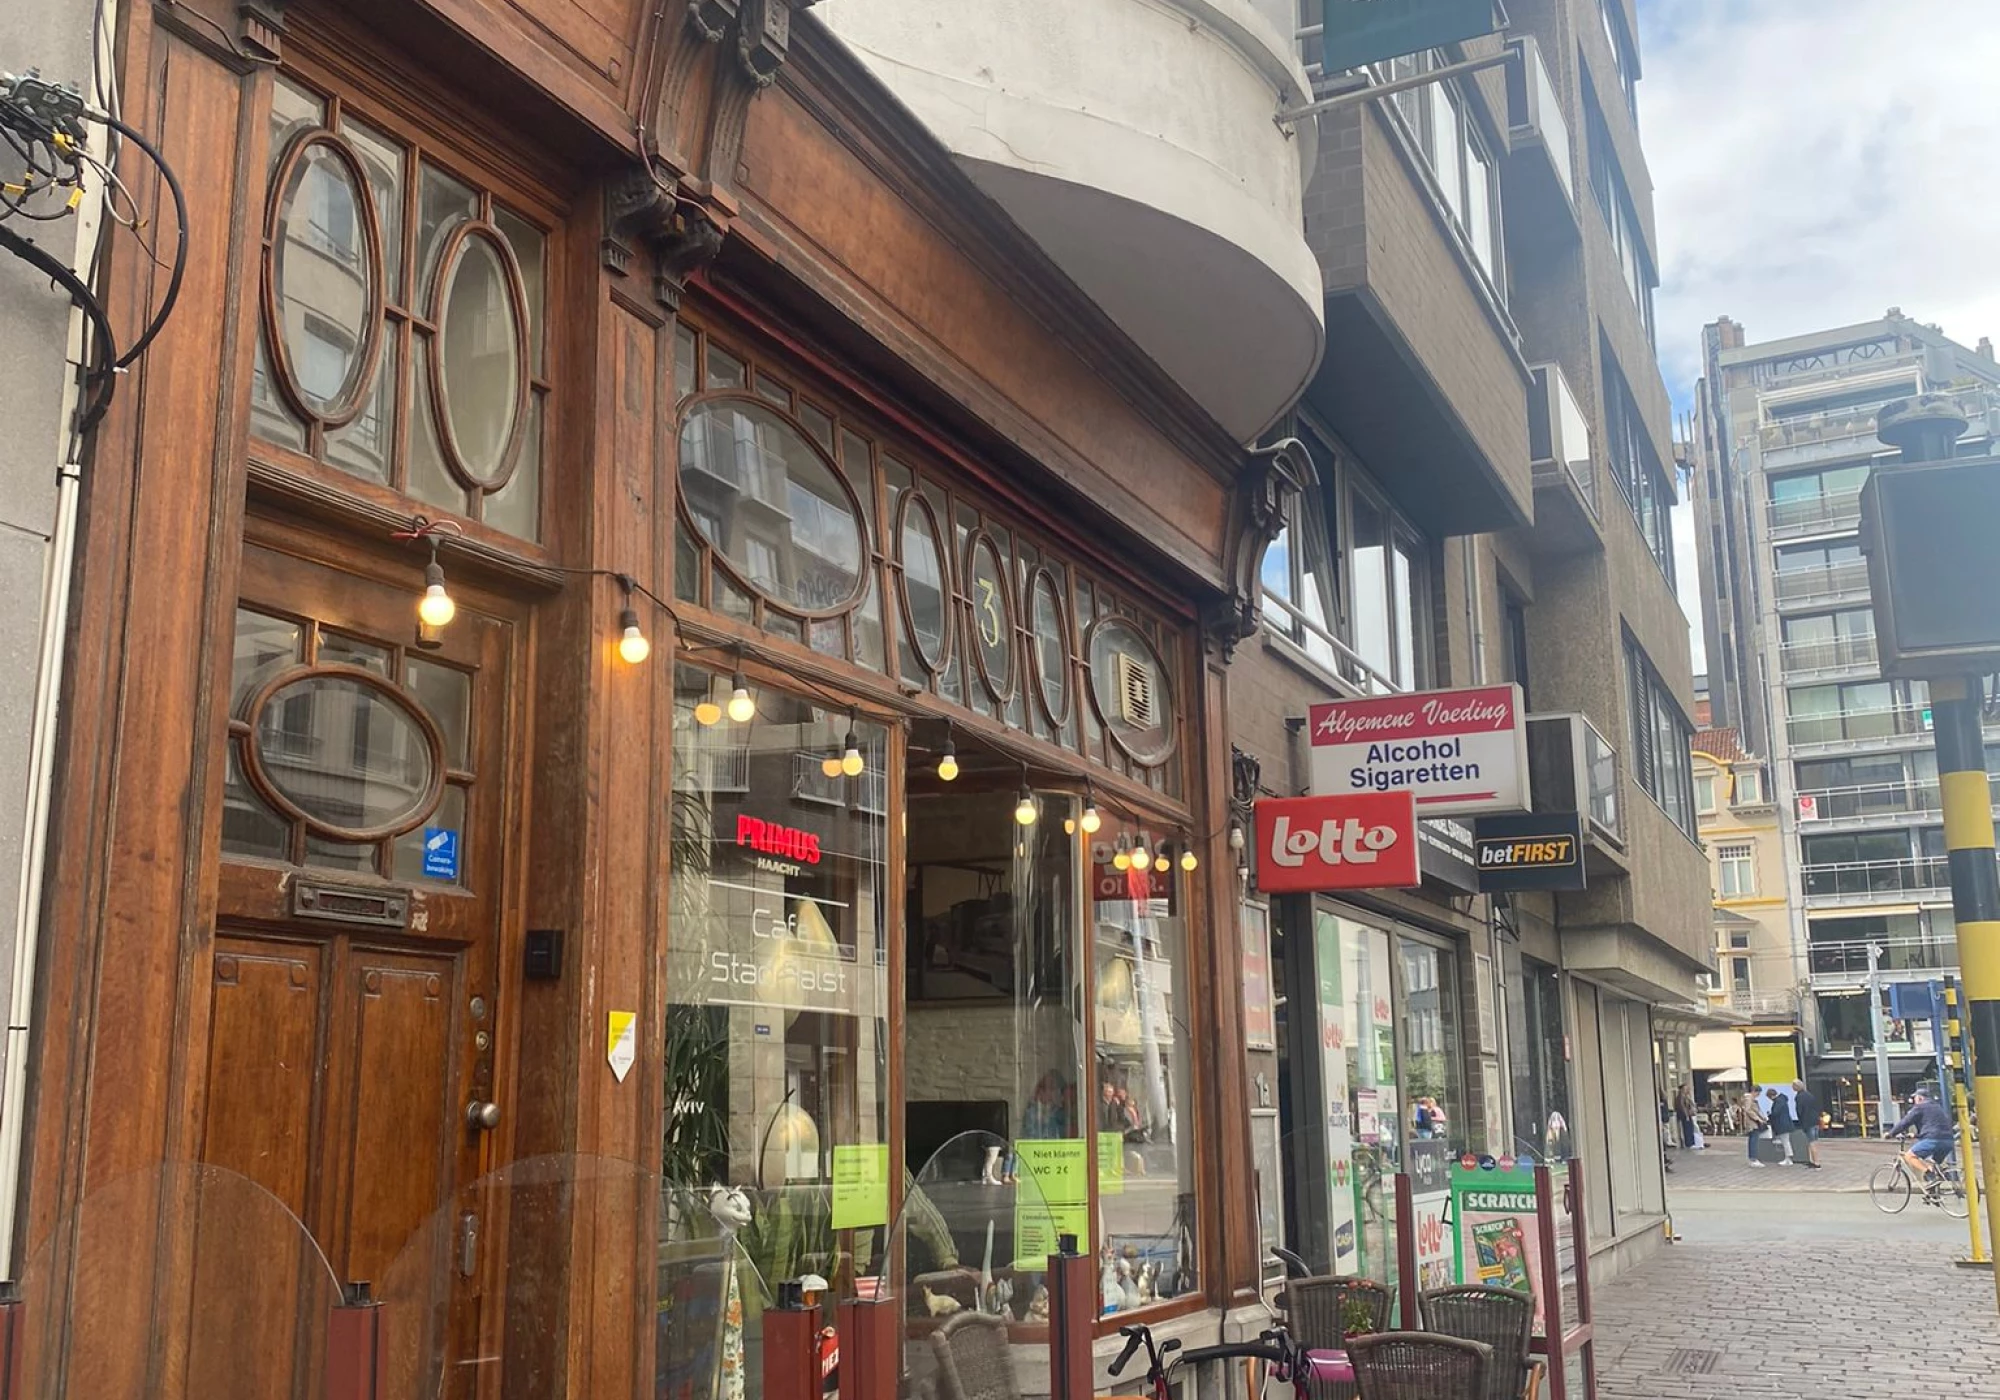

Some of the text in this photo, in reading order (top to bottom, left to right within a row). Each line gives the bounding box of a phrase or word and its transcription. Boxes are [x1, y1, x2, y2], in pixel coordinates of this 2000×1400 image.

[979, 577, 997, 648] 3
[1316, 699, 1508, 741] Algemene Voeding
[1366, 737, 1460, 764] Alcohol
[1350, 763, 1480, 791] Sigaretten
[736, 814, 820, 864] PRIMUS
[1481, 842, 1569, 865] betFIRST
[758, 857, 800, 877] HAACHT
[1034, 1150, 1052, 1158] Niet
[1034, 1166, 1051, 1175] WC
[1468, 1193, 1536, 1208] SCRATCH
